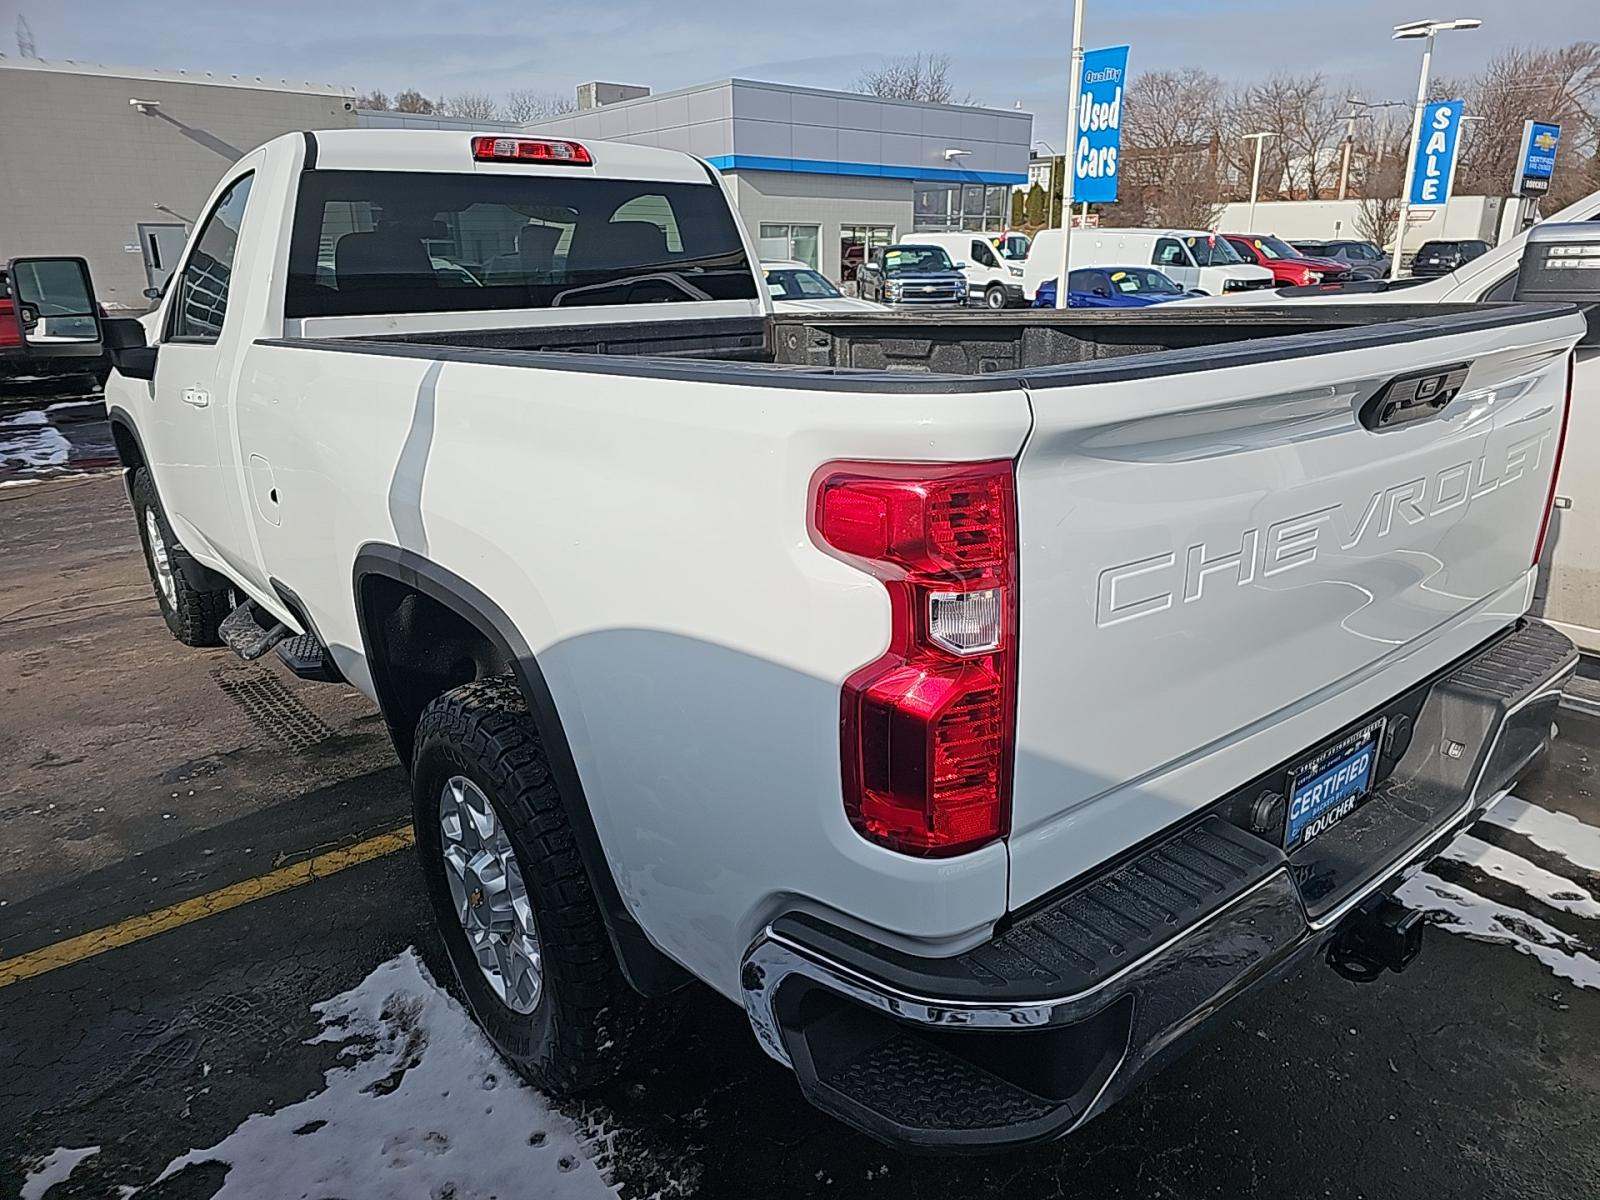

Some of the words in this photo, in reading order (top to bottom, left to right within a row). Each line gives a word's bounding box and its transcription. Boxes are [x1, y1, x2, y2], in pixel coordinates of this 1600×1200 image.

[1085, 67, 1122, 82] Quality
[1079, 86, 1121, 133] Used
[1076, 136, 1117, 179] Cars
[1421, 106, 1452, 201] SALE
[1095, 427, 1552, 628] CHEVROLET
[1289, 752, 1370, 821] CERTIFIED
[1303, 794, 1356, 842] BOUCHER
